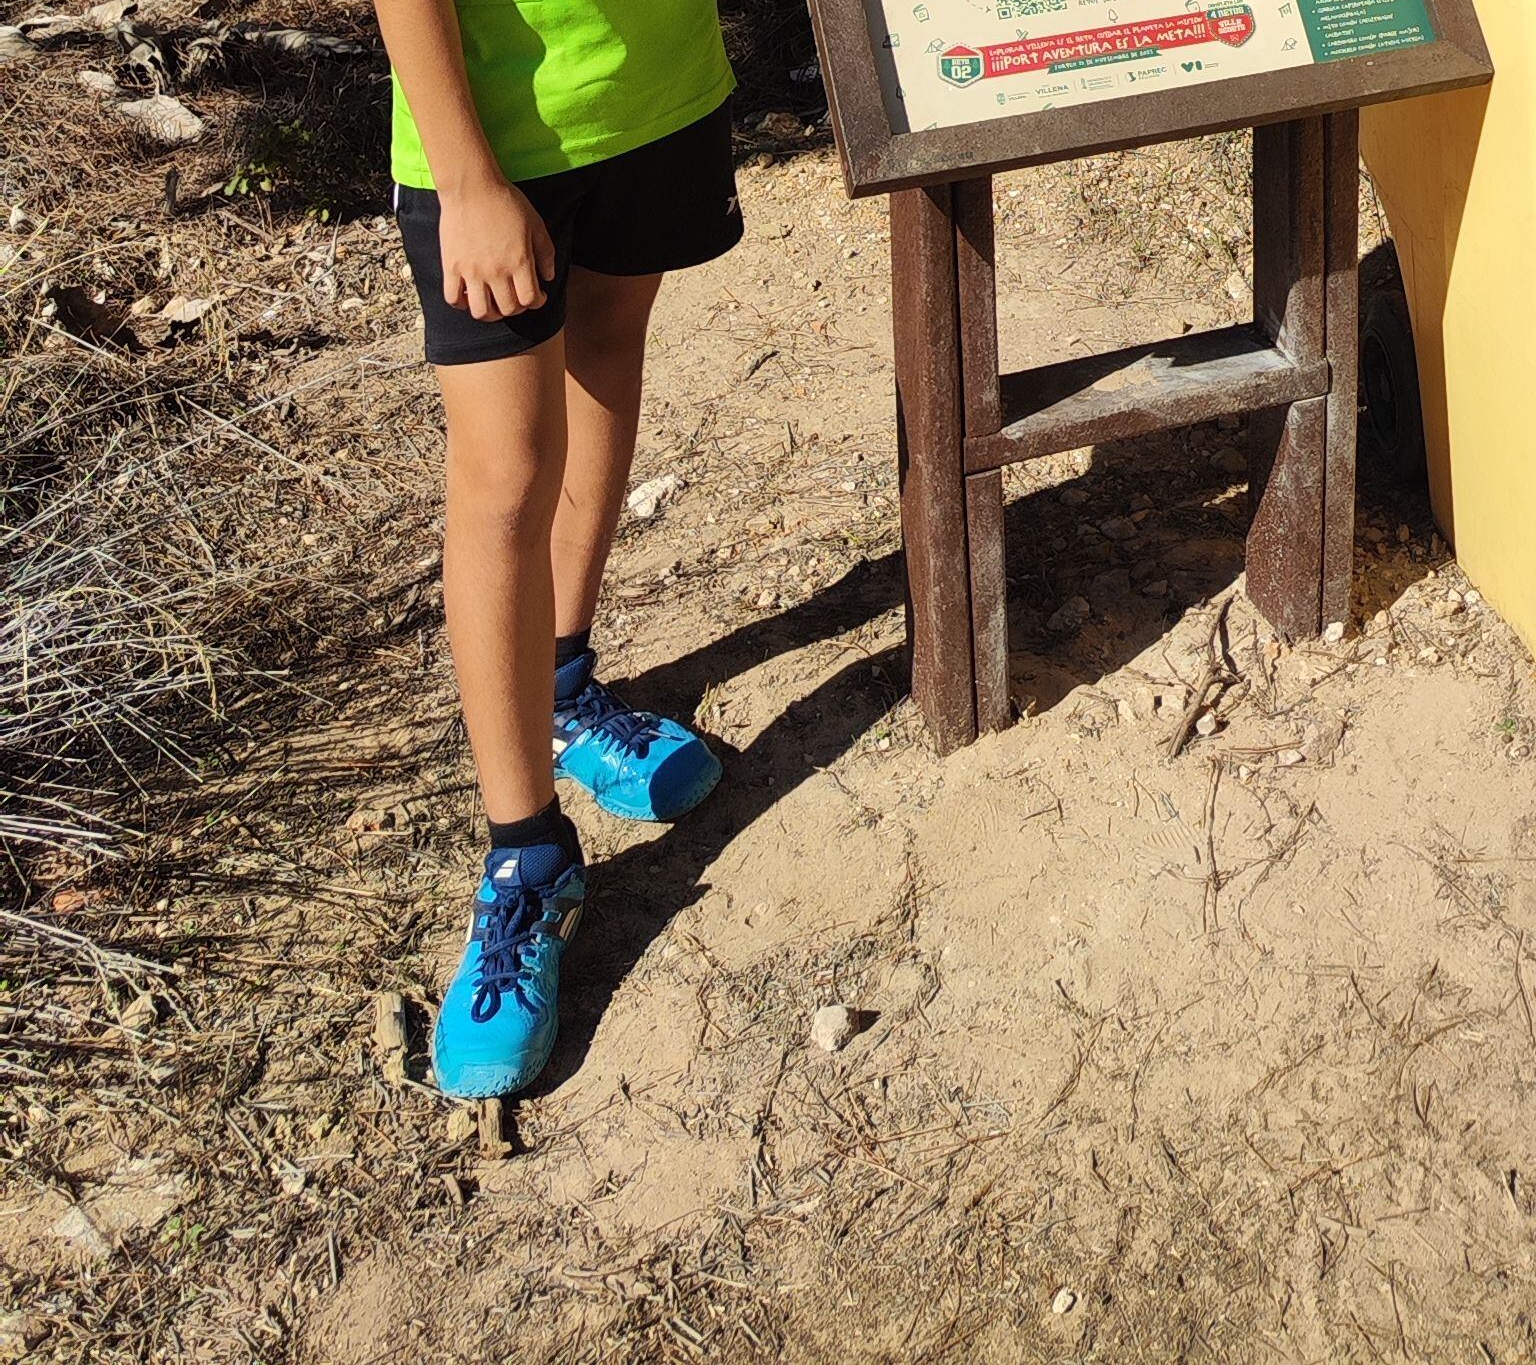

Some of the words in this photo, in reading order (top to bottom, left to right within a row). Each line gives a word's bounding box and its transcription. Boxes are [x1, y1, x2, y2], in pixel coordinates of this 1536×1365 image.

[1026, 40, 1056, 51] VILLENA
[1132, 22, 1164, 34] PLANETA
[1164, 21, 1175, 29] LA
[1042, 41, 1112, 61] AVENTURA
[1116, 38, 1129, 50] ES
[1133, 35, 1153, 46] LA
[1157, 23, 1206, 42] META!!!
[951, 66, 972, 79] 02
[1137, 66, 1167, 77] PAPREC
[1035, 84, 1069, 95] VILLENA
